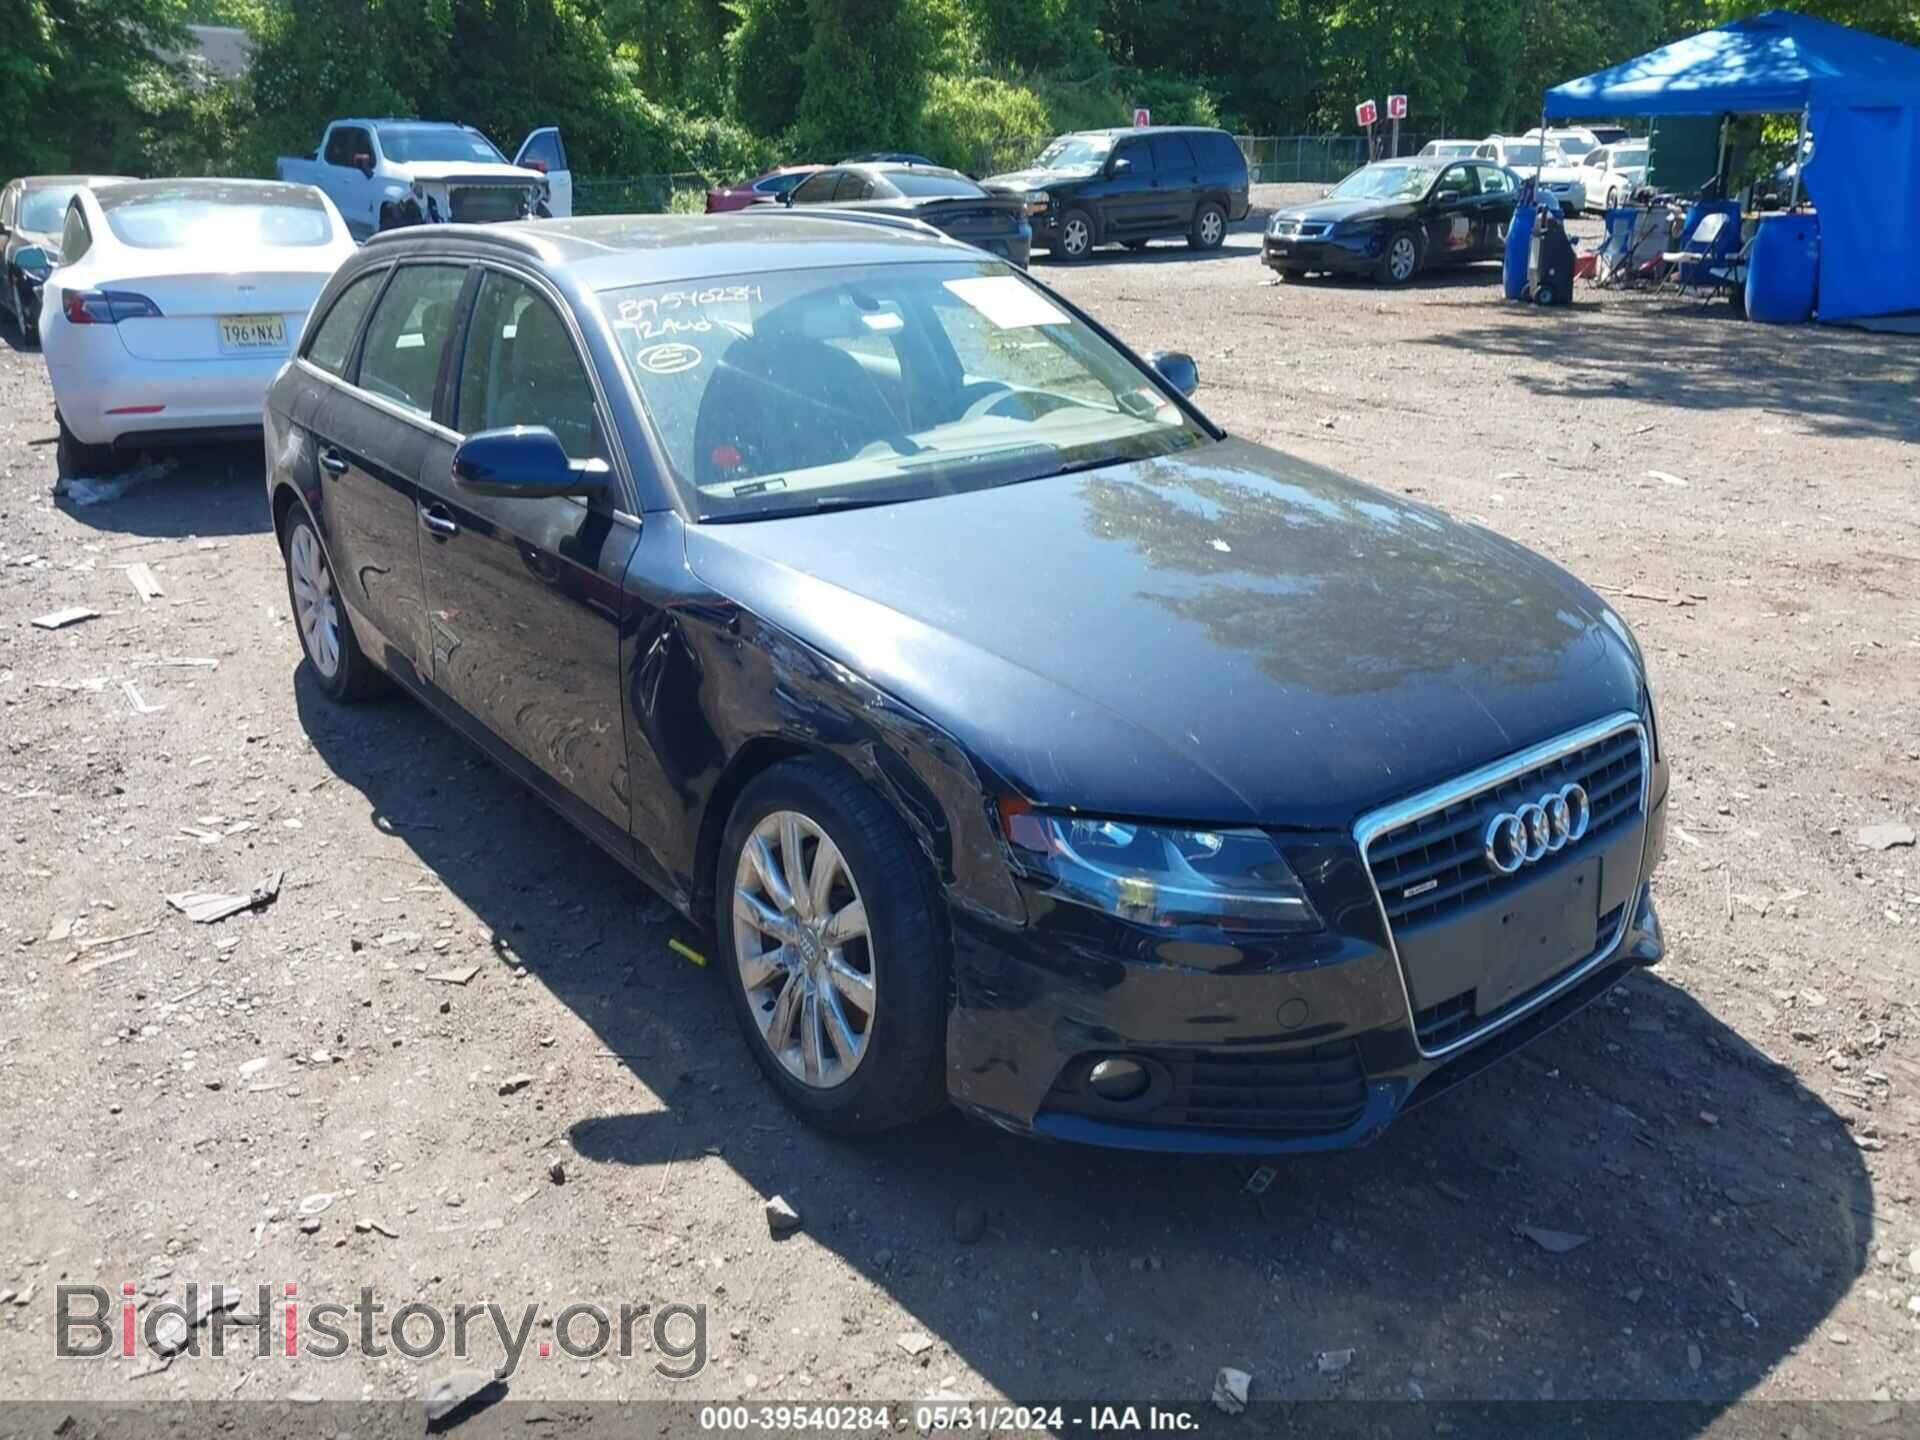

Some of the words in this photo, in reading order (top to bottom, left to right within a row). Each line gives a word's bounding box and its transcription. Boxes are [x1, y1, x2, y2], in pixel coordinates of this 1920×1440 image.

[1360, 104, 1376, 123] B
[1391, 97, 1406, 117] C
[1136, 111, 1148, 128] A
